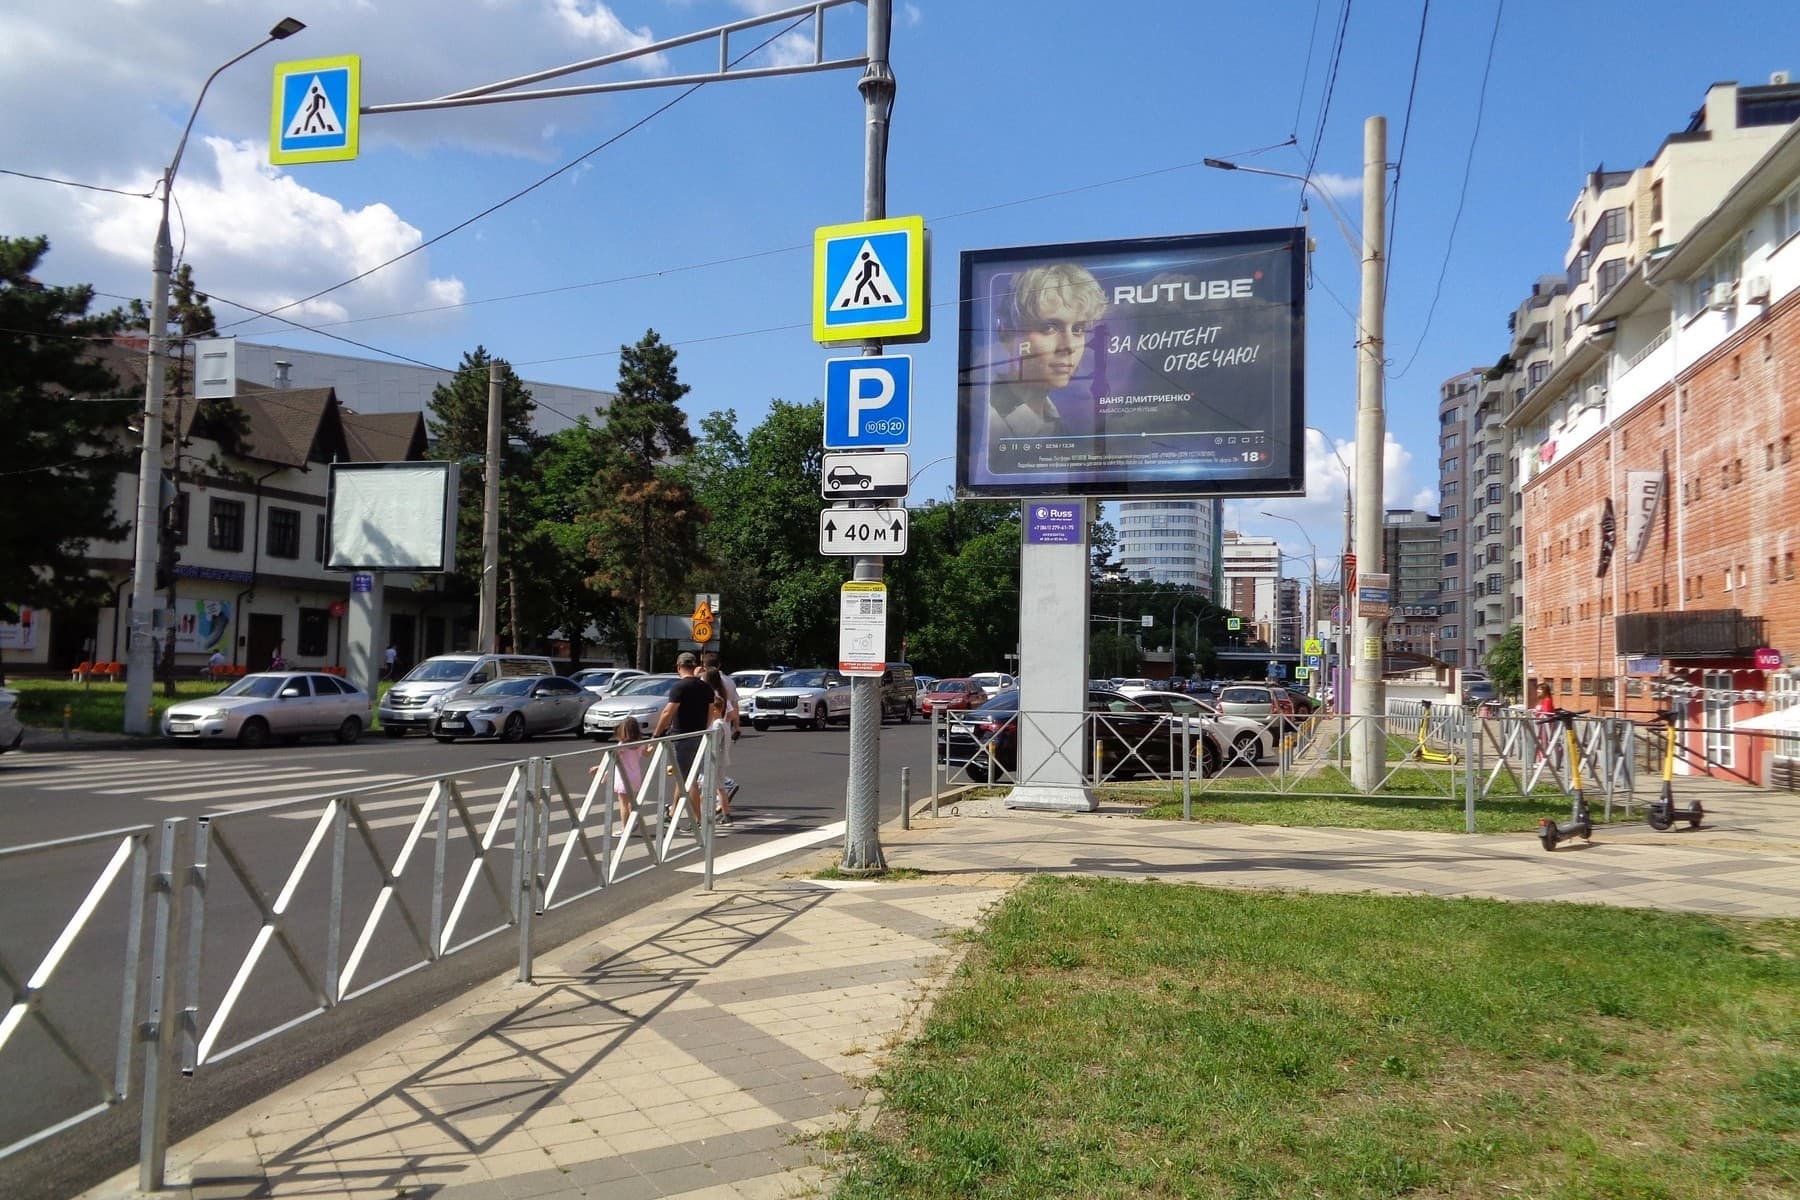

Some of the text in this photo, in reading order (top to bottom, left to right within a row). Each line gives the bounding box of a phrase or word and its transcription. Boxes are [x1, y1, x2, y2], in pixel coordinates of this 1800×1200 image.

[1113, 278, 1254, 305] RUTUBE
[1107, 326, 1222, 354] ЗА КОНТЕНТ
[1163, 344, 1260, 373] ОТВЕЧАЮ!
[848, 368, 896, 437] P
[1099, 393, 1192, 405] ВАНЯ ДМИТРИЕНКО
[878, 423, 887, 431] 15
[890, 422, 902, 431] 20
[1241, 451, 1267, 463] 18+
[1050, 509, 1073, 518] Russ
[844, 524, 870, 541] 40
[696, 627, 708, 636] 40
[1758, 655, 1780, 665] WB
